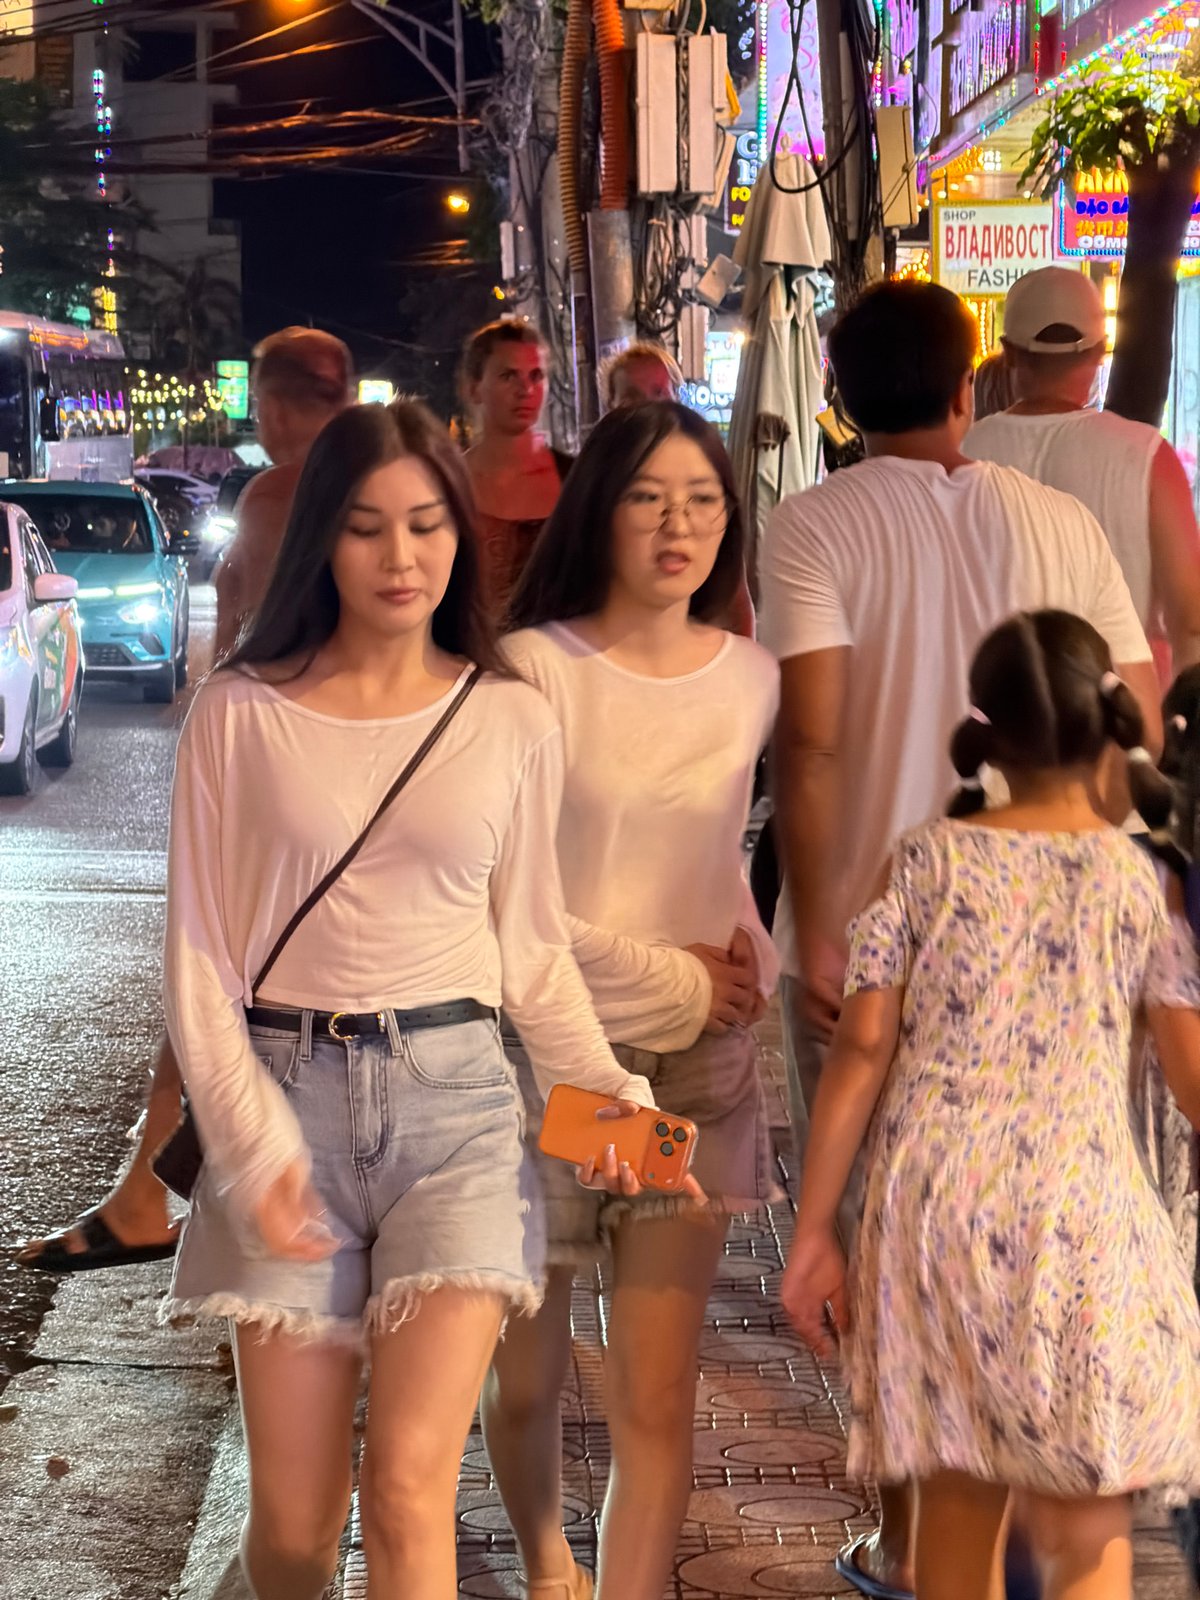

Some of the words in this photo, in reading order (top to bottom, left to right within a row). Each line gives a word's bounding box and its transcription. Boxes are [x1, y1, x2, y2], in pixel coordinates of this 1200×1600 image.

[943, 210, 976, 220] SHOP
[945, 223, 1049, 266] ВЛАДИВОСТ
[967, 268, 1024, 287] FASH
